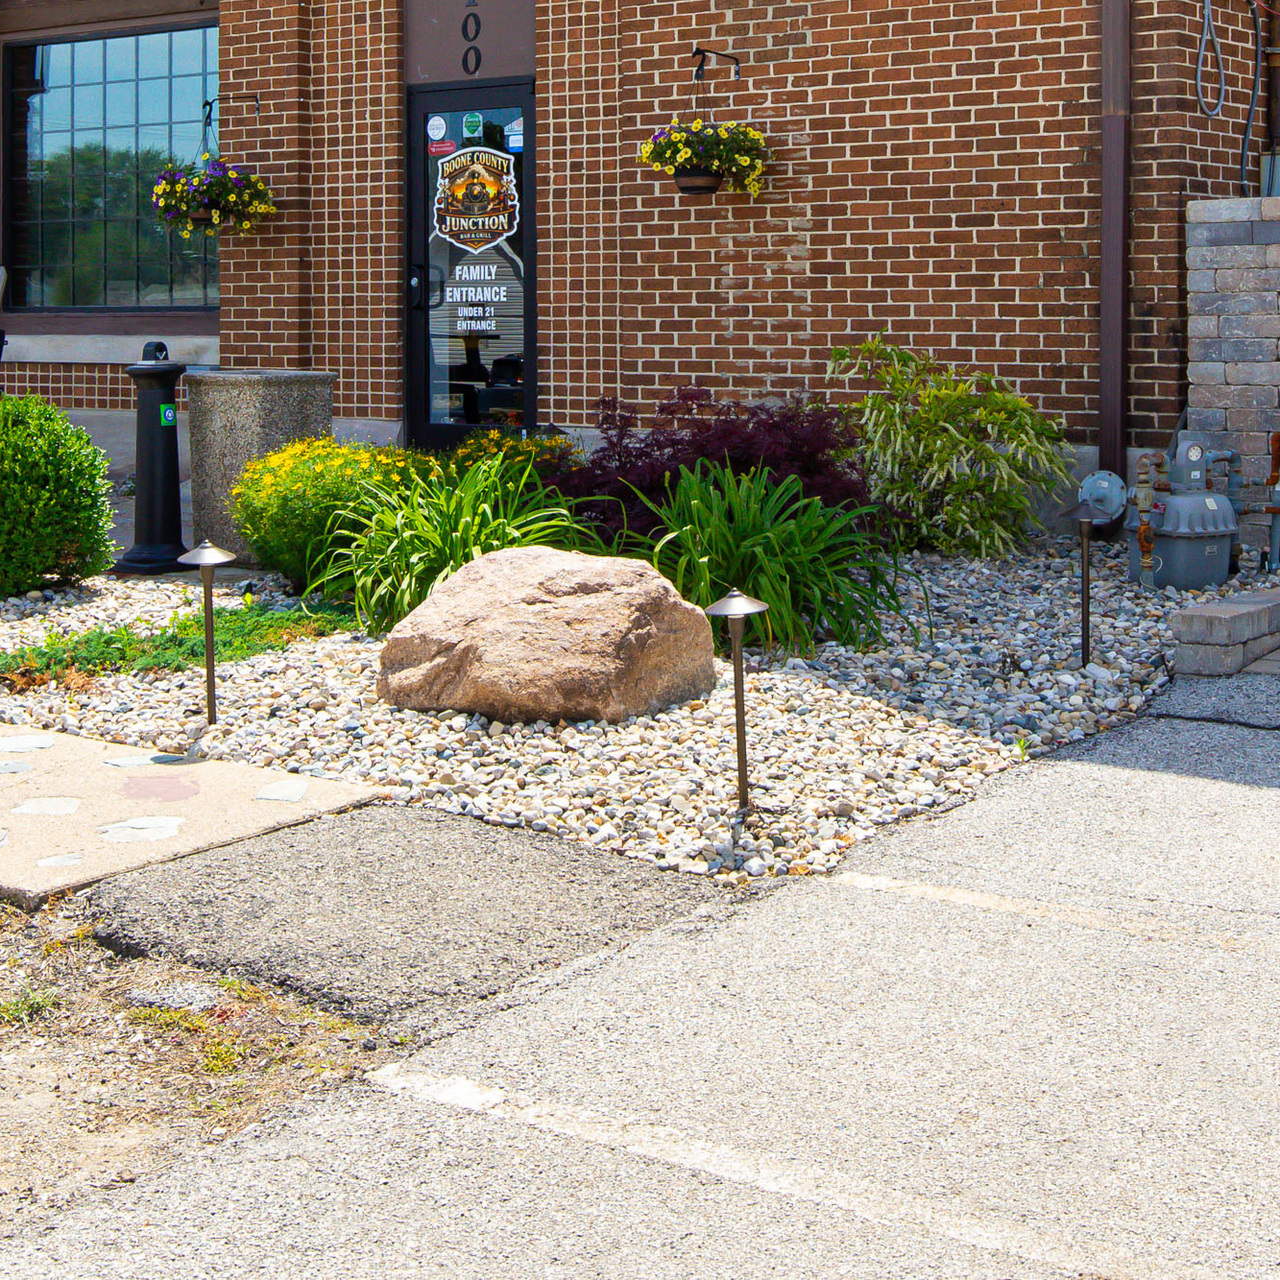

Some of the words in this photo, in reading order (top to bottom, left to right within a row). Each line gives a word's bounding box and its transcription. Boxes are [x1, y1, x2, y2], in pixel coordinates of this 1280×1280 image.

[443, 153, 472, 177] BOONE
[474, 152, 509, 173] COUNTY
[442, 213, 509, 232] JUNCTION
[455, 264, 497, 280] FAMILY
[446, 287, 507, 302] ENTRANCE
[458, 307, 483, 317] UNDER
[485, 307, 494, 317] 21
[456, 320, 496, 331] ENTRANCE
